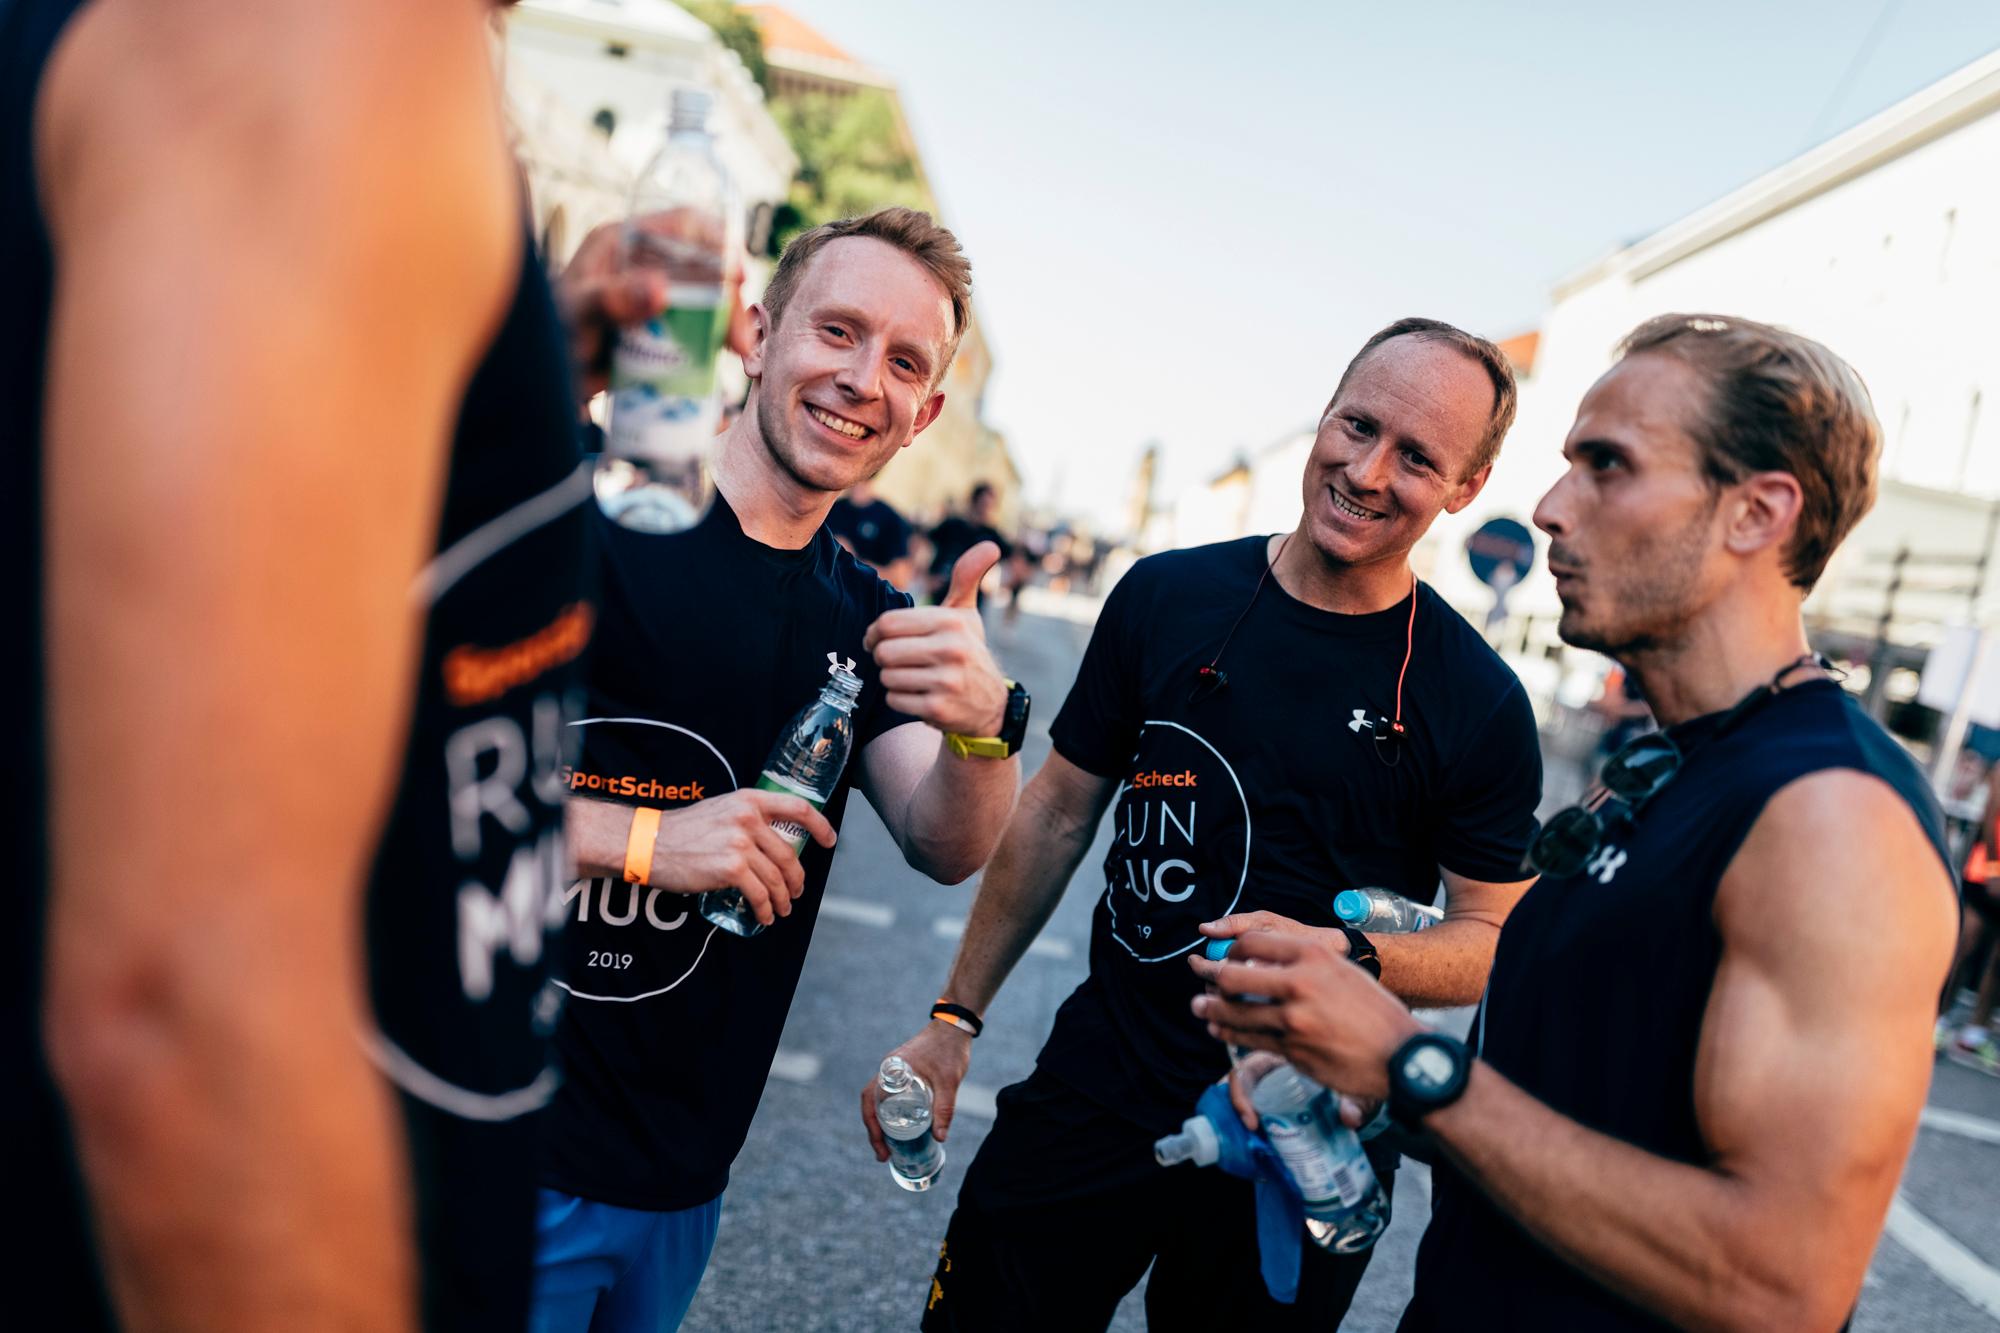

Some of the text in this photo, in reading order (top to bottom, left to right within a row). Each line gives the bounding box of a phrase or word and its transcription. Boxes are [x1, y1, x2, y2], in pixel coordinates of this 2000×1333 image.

[1133, 770, 1198, 789] Scheck
[1128, 800, 1196, 847] UN
[1125, 858, 1196, 903] UC
[1137, 924, 1152, 940] 19
[587, 950, 634, 970] 2019
